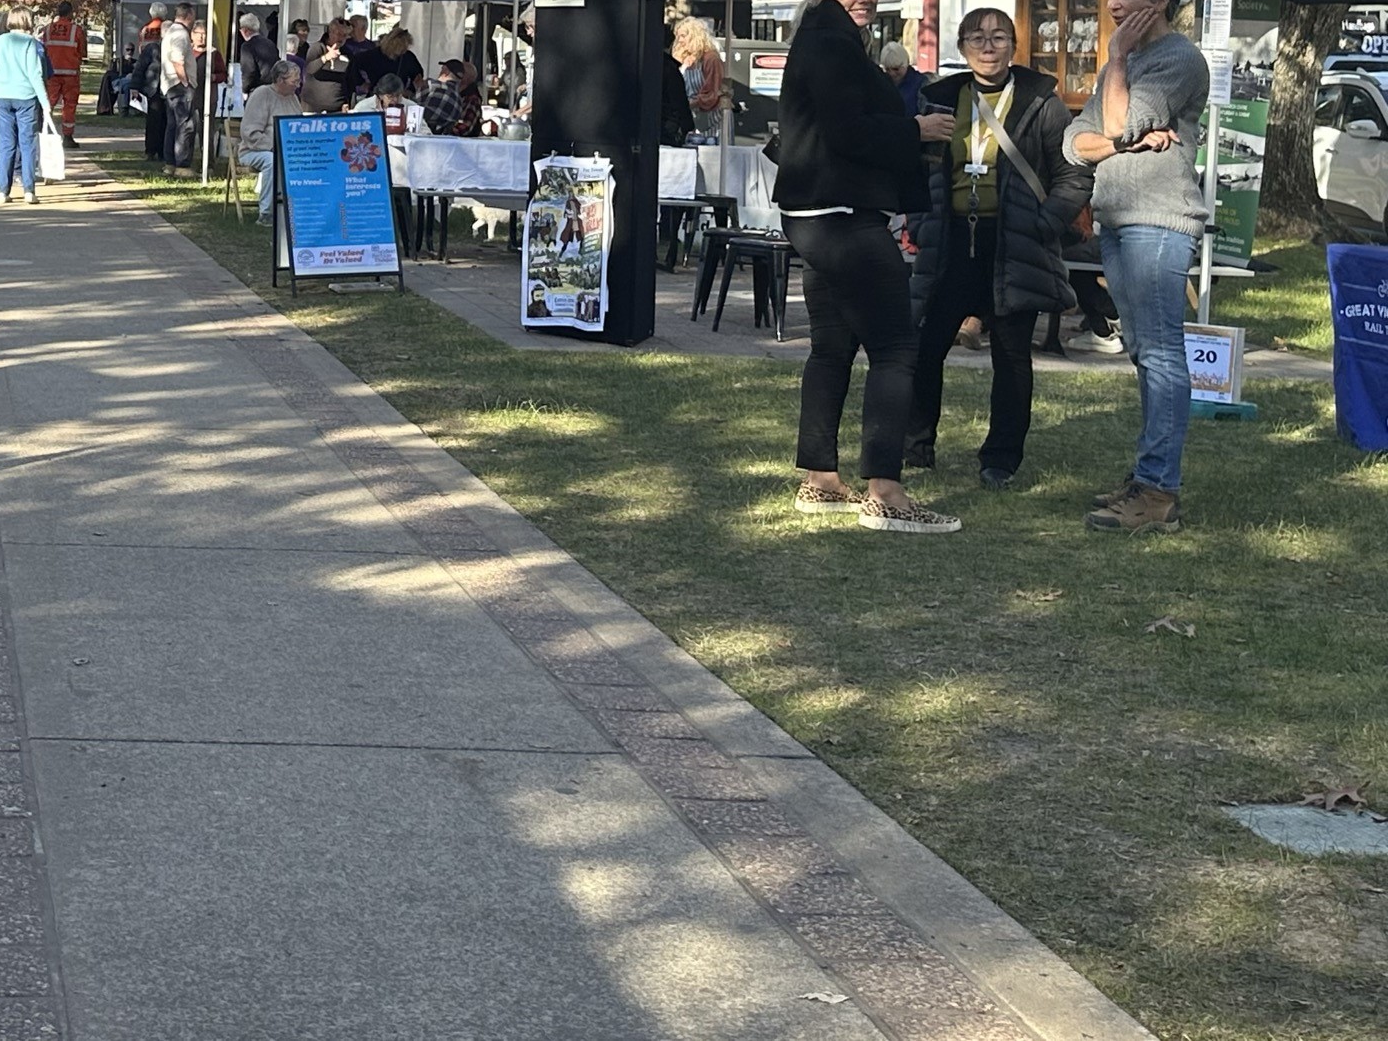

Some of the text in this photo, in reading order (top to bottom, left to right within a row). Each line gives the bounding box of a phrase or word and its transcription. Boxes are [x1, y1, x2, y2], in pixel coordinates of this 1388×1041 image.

[288, 119, 372, 133] Talk to us
[1345, 304, 1375, 317] GREAT
[1364, 321, 1384, 335] RAIL
[1193, 349, 1218, 364] 20
